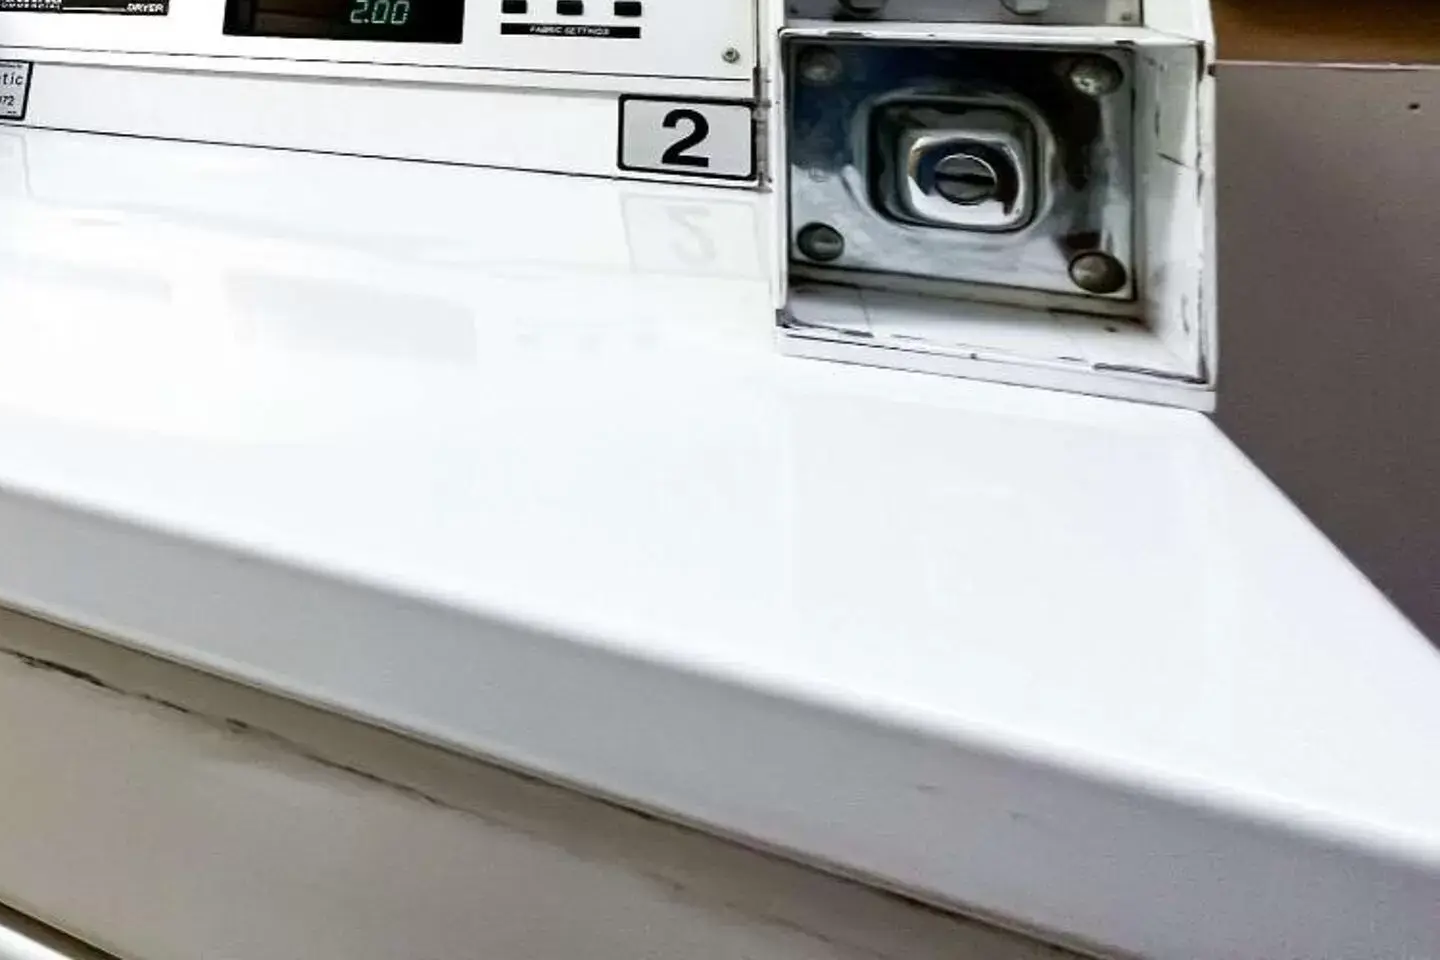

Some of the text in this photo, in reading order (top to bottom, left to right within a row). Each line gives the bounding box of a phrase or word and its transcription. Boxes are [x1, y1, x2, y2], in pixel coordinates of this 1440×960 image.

[125, 2, 165, 13] DRYER
[350, 0, 410, 25] 2.00
[662, 108, 709, 168] 2
